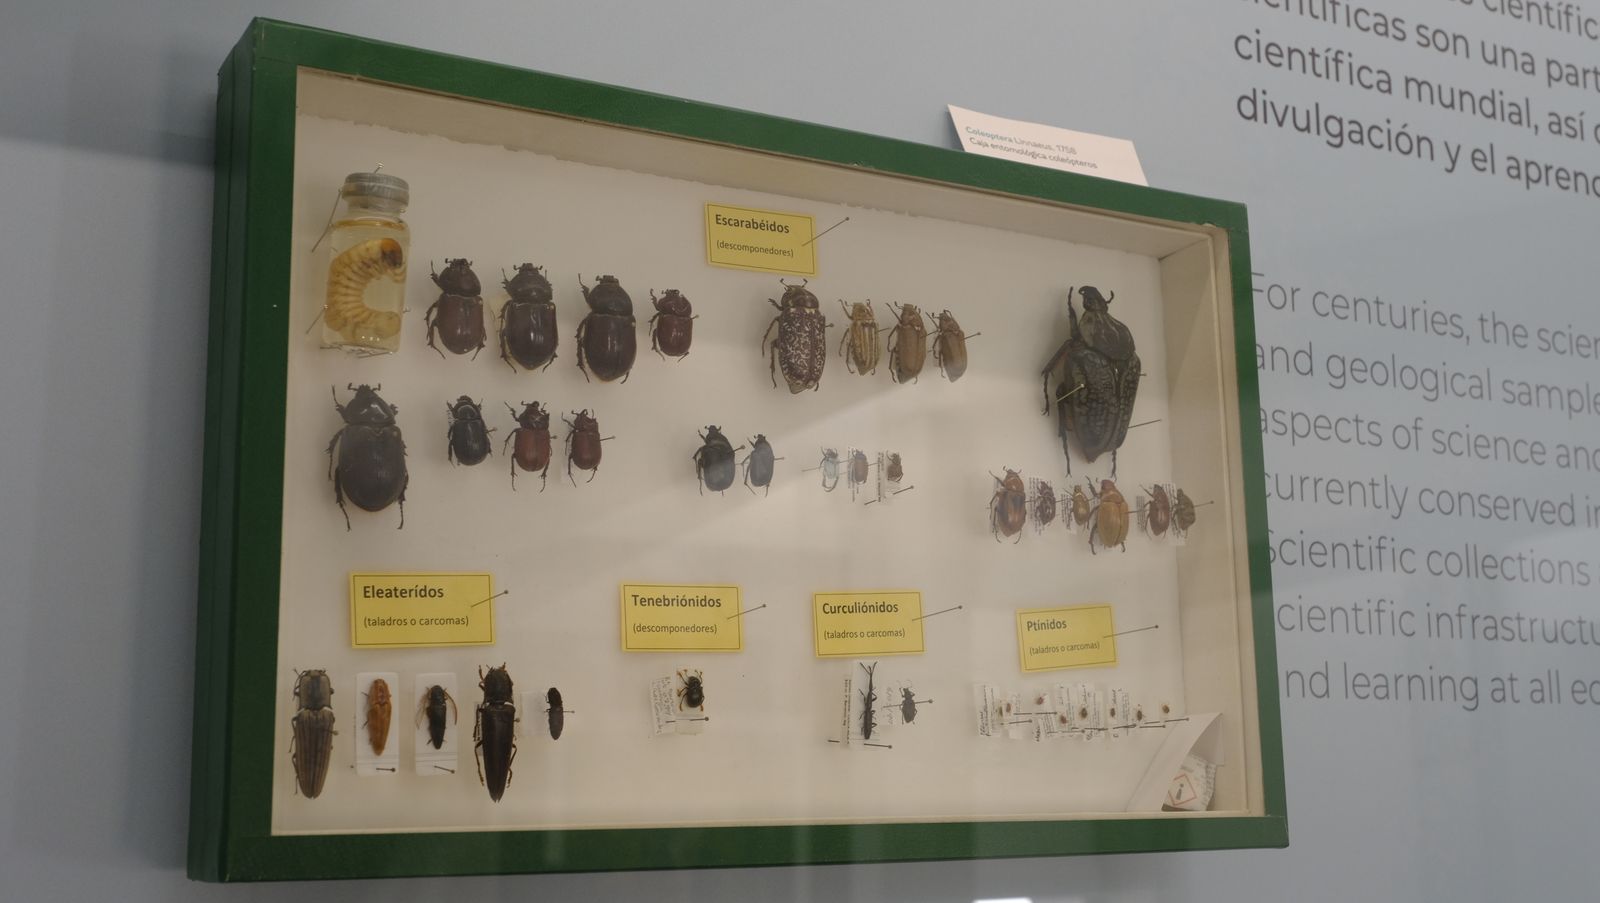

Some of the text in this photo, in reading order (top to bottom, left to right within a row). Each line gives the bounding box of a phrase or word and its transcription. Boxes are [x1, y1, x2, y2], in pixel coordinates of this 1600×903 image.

[1416, 24, 1470, 59] son
[1481, 40, 1536, 76] una
[1234, 29, 1585, 141] científica mundial, así
[1237, 88, 1434, 161] divulgación
[1444, 142, 1461, 173] y
[1471, 144, 1496, 174] el
[715, 214, 790, 234] Escarabéidos
[716, 240, 794, 257] (descomponedores)
[1312, 291, 1471, 345] centuries,
[1478, 311, 1529, 348] the
[1326, 353, 1492, 402] geological
[1392, 417, 1423, 451] of
[1432, 424, 1546, 466] science
[1418, 487, 1576, 527] conserved
[1426, 543, 1591, 586] collections
[363, 584, 444, 598] Eleaterídos
[631, 594, 722, 608] Tenebriónidos
[822, 602, 899, 615] Curculiónidos
[363, 616, 470, 629] (taladros o carcomas)
[632, 623, 718, 635] (descomponedores)
[1026, 619, 1068, 632] Ptínidos
[823, 630, 858, 640] (taladros
[866, 628, 906, 639] carcomas)
[1029, 645, 1060, 656] (taladros
[1066, 641, 1101, 652] carcomas)
[1343, 662, 1480, 711] learning
[1490, 673, 1520, 704] at
[1530, 669, 1562, 704] all
